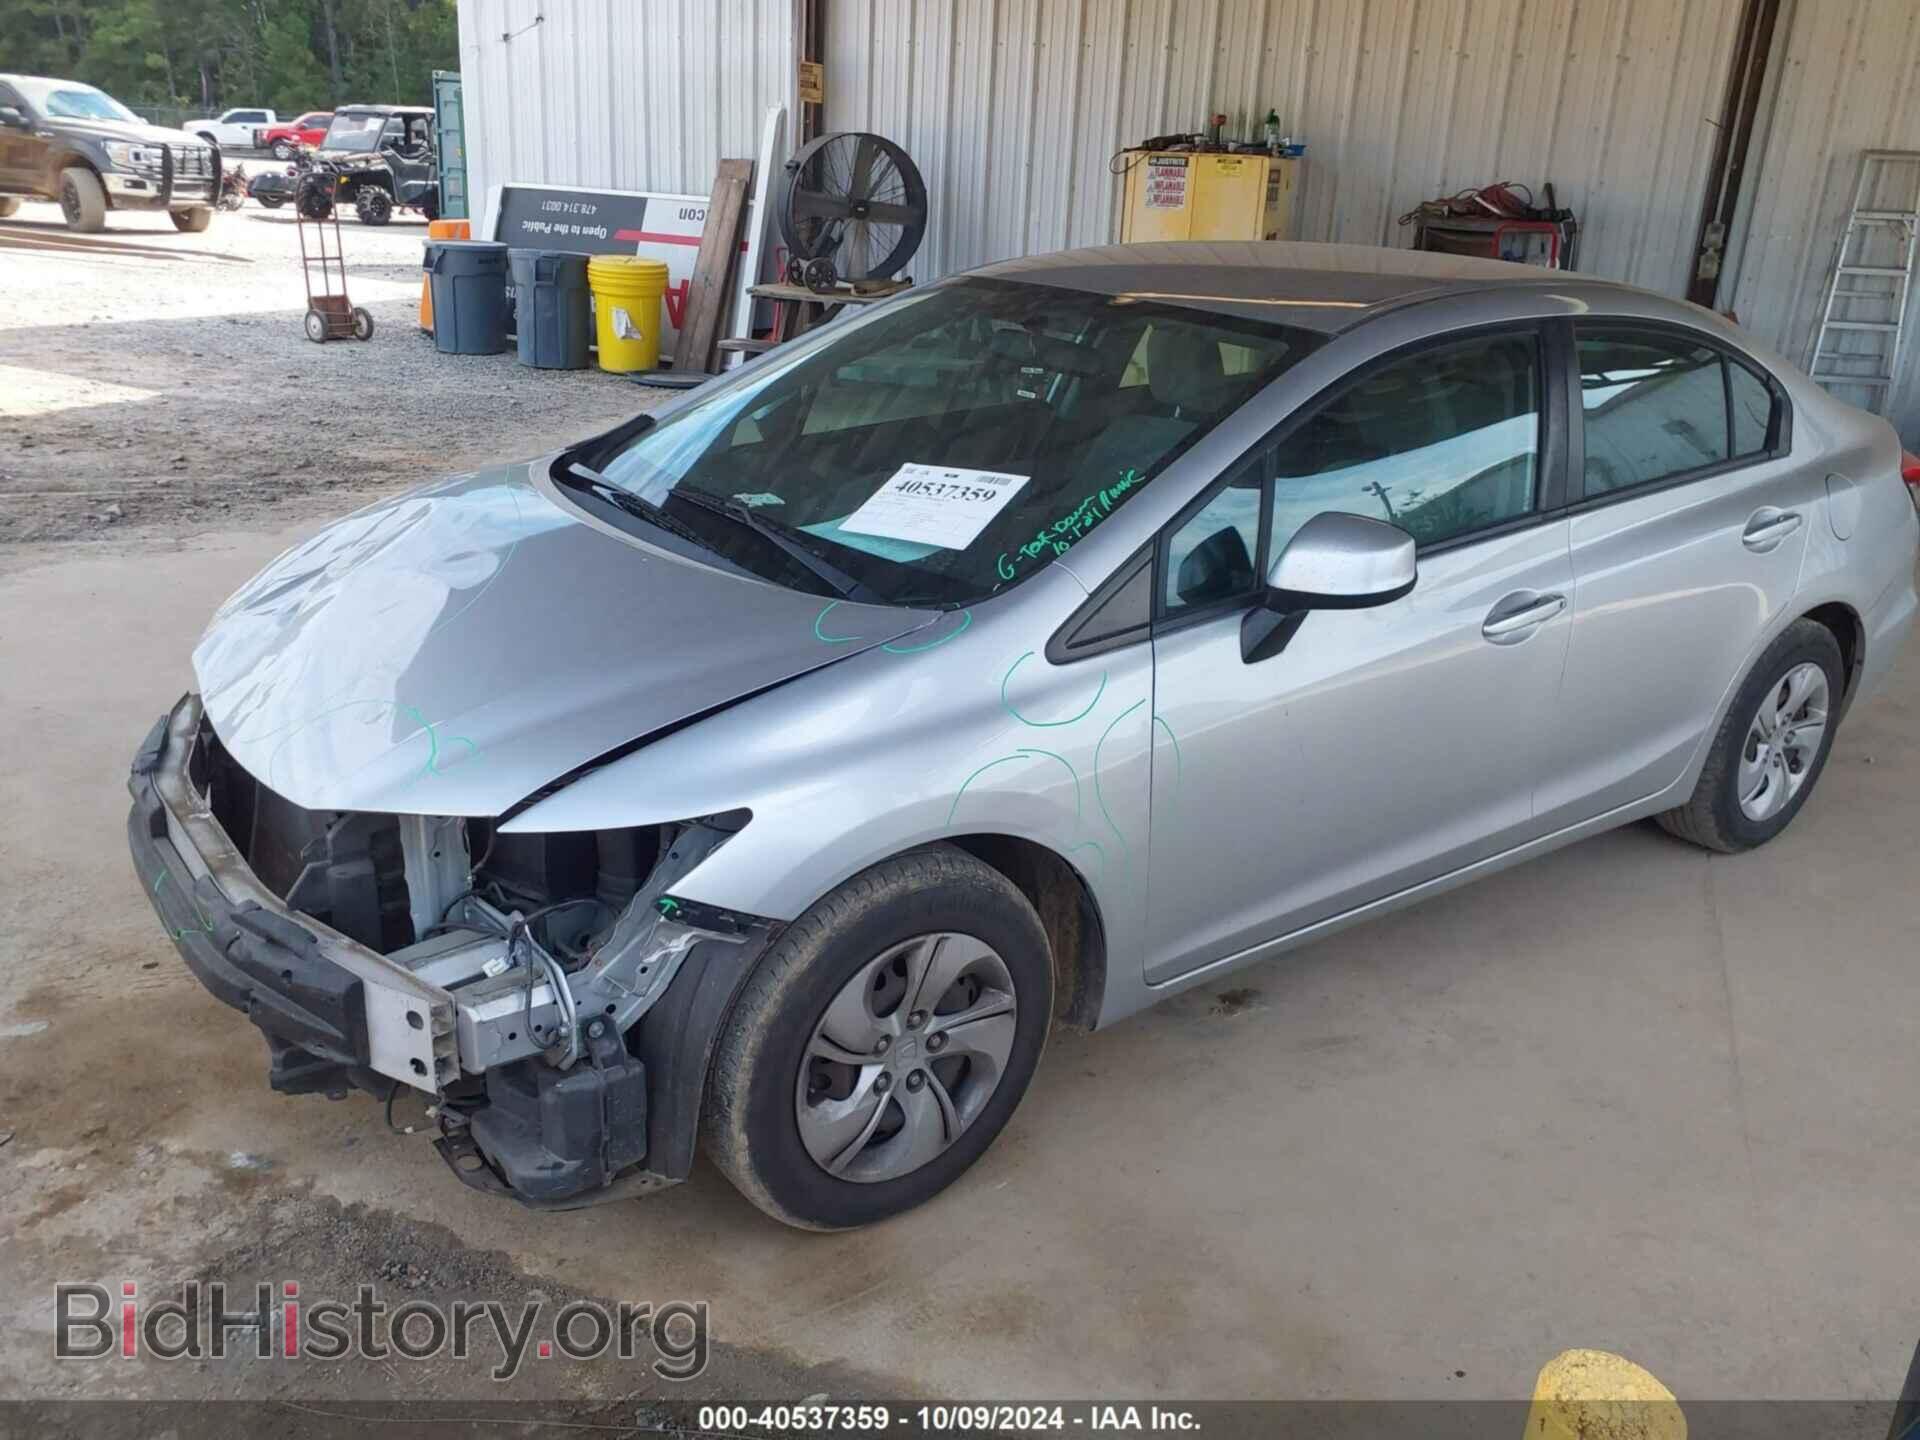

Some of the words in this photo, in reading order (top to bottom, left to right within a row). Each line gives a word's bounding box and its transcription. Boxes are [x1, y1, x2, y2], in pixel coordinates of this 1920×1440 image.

[678, 207, 706, 222] con
[521, 220, 552, 234] Public
[553, 223, 569, 235] the
[571, 225, 581, 235] to
[582, 226, 608, 240] Open
[896, 479, 997, 502] 40537359
